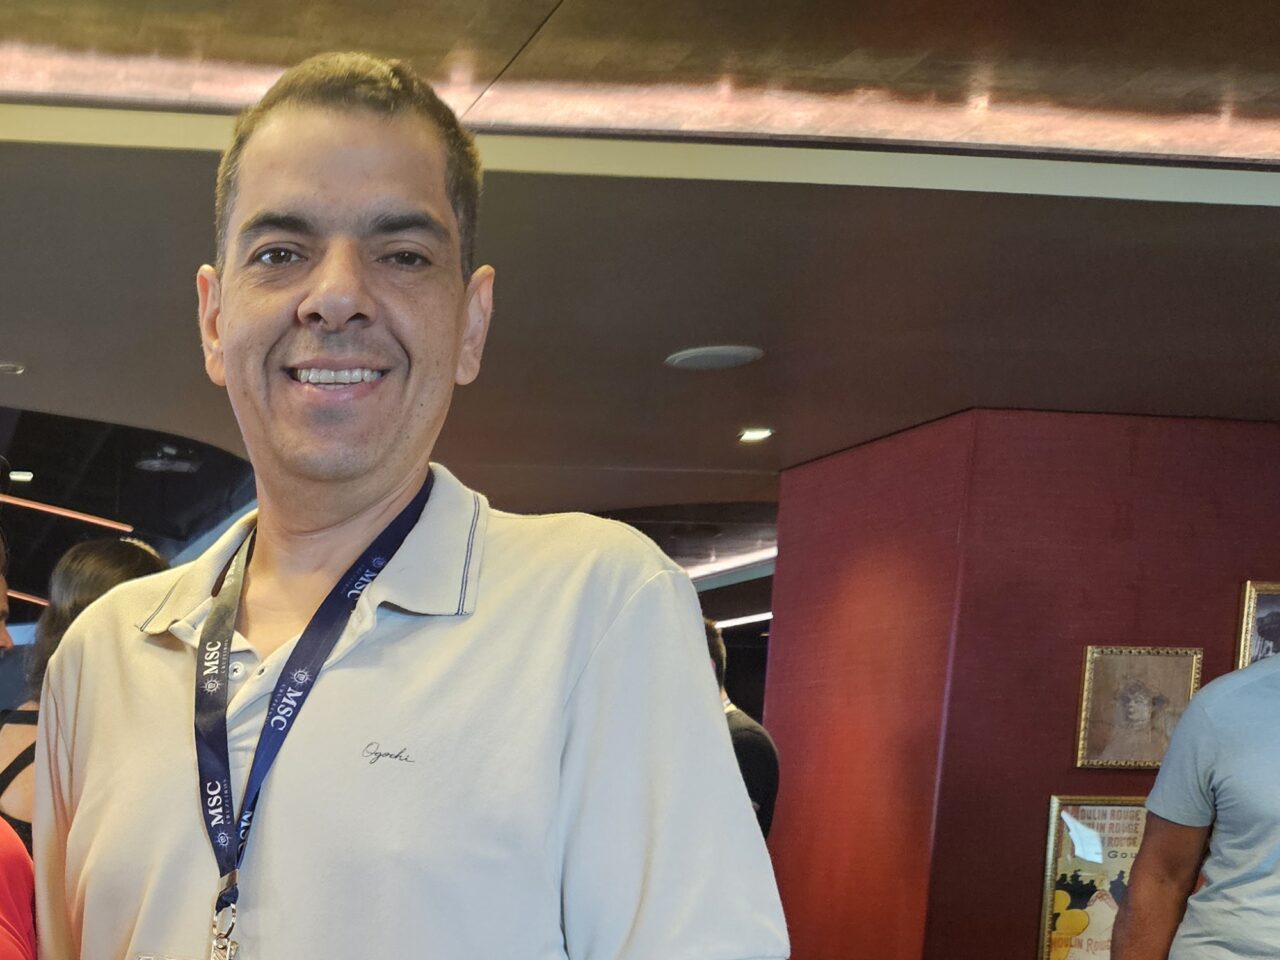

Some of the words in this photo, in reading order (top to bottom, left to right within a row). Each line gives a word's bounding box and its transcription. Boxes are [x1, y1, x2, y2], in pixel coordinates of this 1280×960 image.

[347, 569, 378, 599] MSC
[203, 640, 222, 676] MSC
[270, 686, 304, 731] MSC
[206, 780, 224, 828] MSC
[1110, 809, 1140, 821] ROUGE
[1109, 822, 1139, 834] ROUGE
